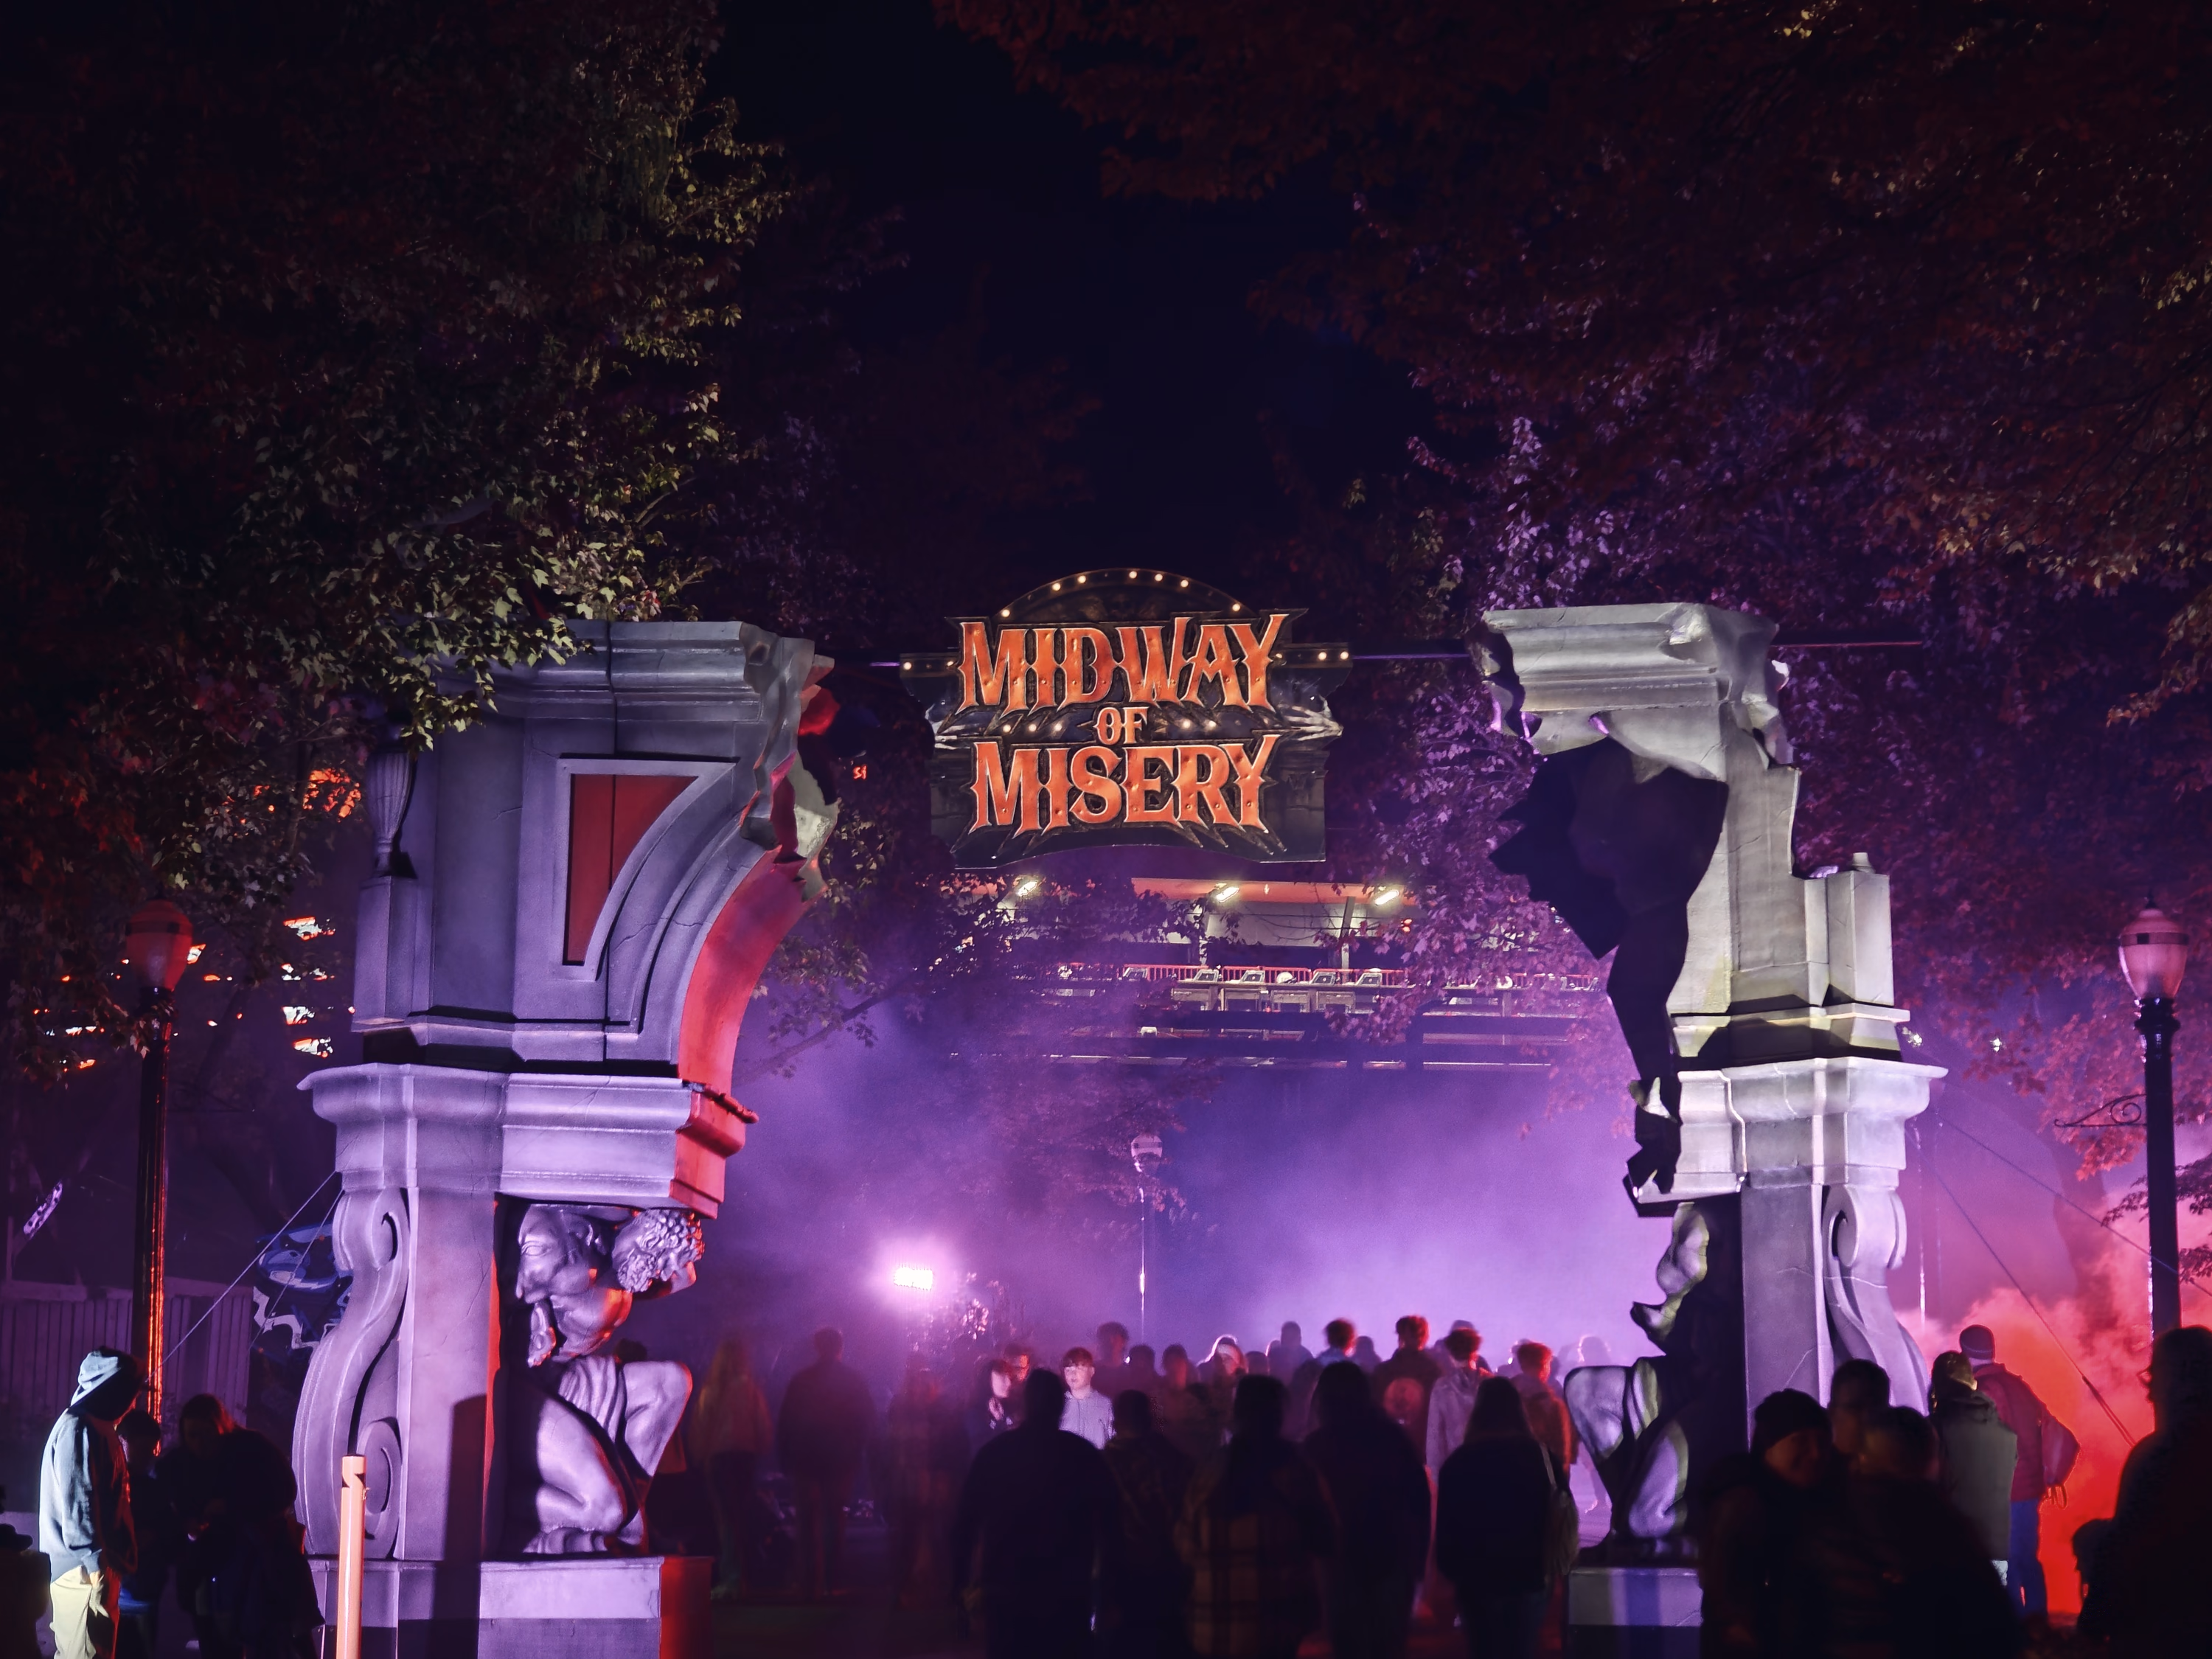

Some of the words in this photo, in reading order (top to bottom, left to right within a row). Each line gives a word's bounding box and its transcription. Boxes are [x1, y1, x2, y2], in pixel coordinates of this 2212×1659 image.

[956, 613, 1290, 717] MIDWAY
[1093, 706, 1148, 744] OF
[967, 734, 1282, 837] MISERY
